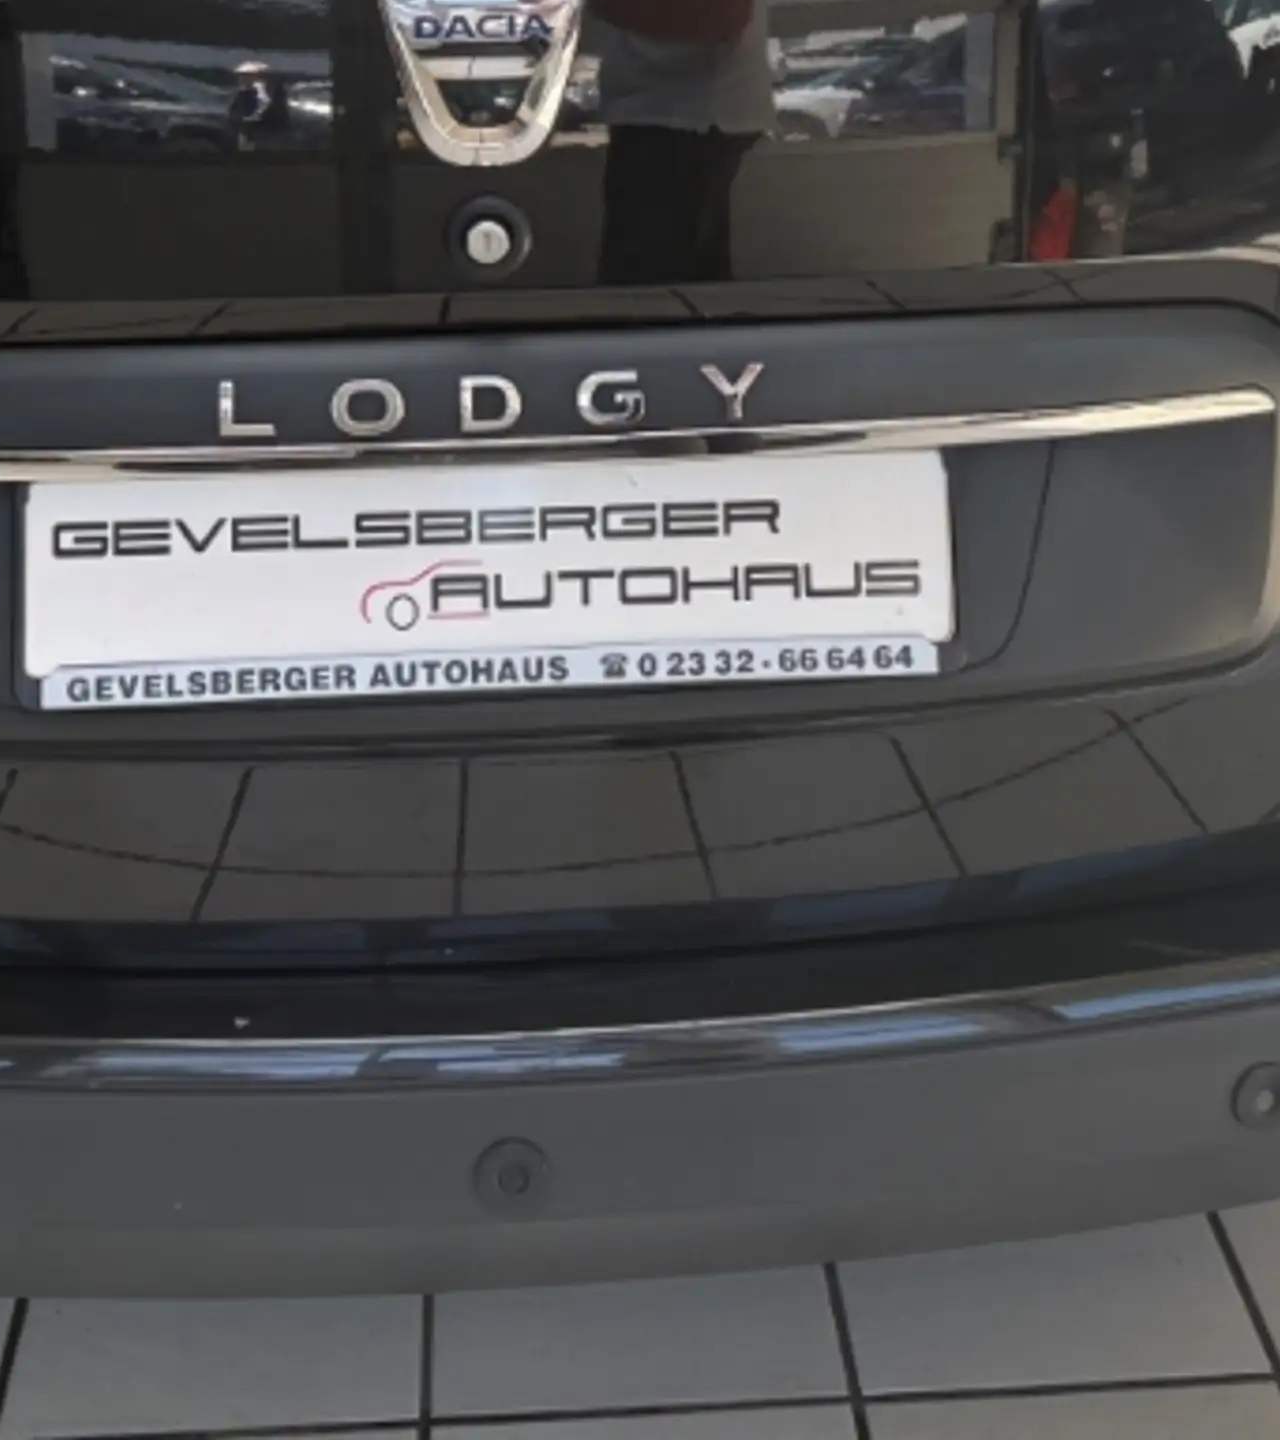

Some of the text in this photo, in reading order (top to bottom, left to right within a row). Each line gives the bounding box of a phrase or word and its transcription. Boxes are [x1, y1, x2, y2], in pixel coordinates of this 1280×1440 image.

[414, 13, 553, 39] DACIA
[219, 362, 764, 437] LODGY
[51, 498, 781, 559] GEVELSBERGER
[429, 560, 922, 613] AUTOHAUS
[65, 662, 357, 703] GEVELSBERGER
[368, 654, 571, 688] AUTOHAUS
